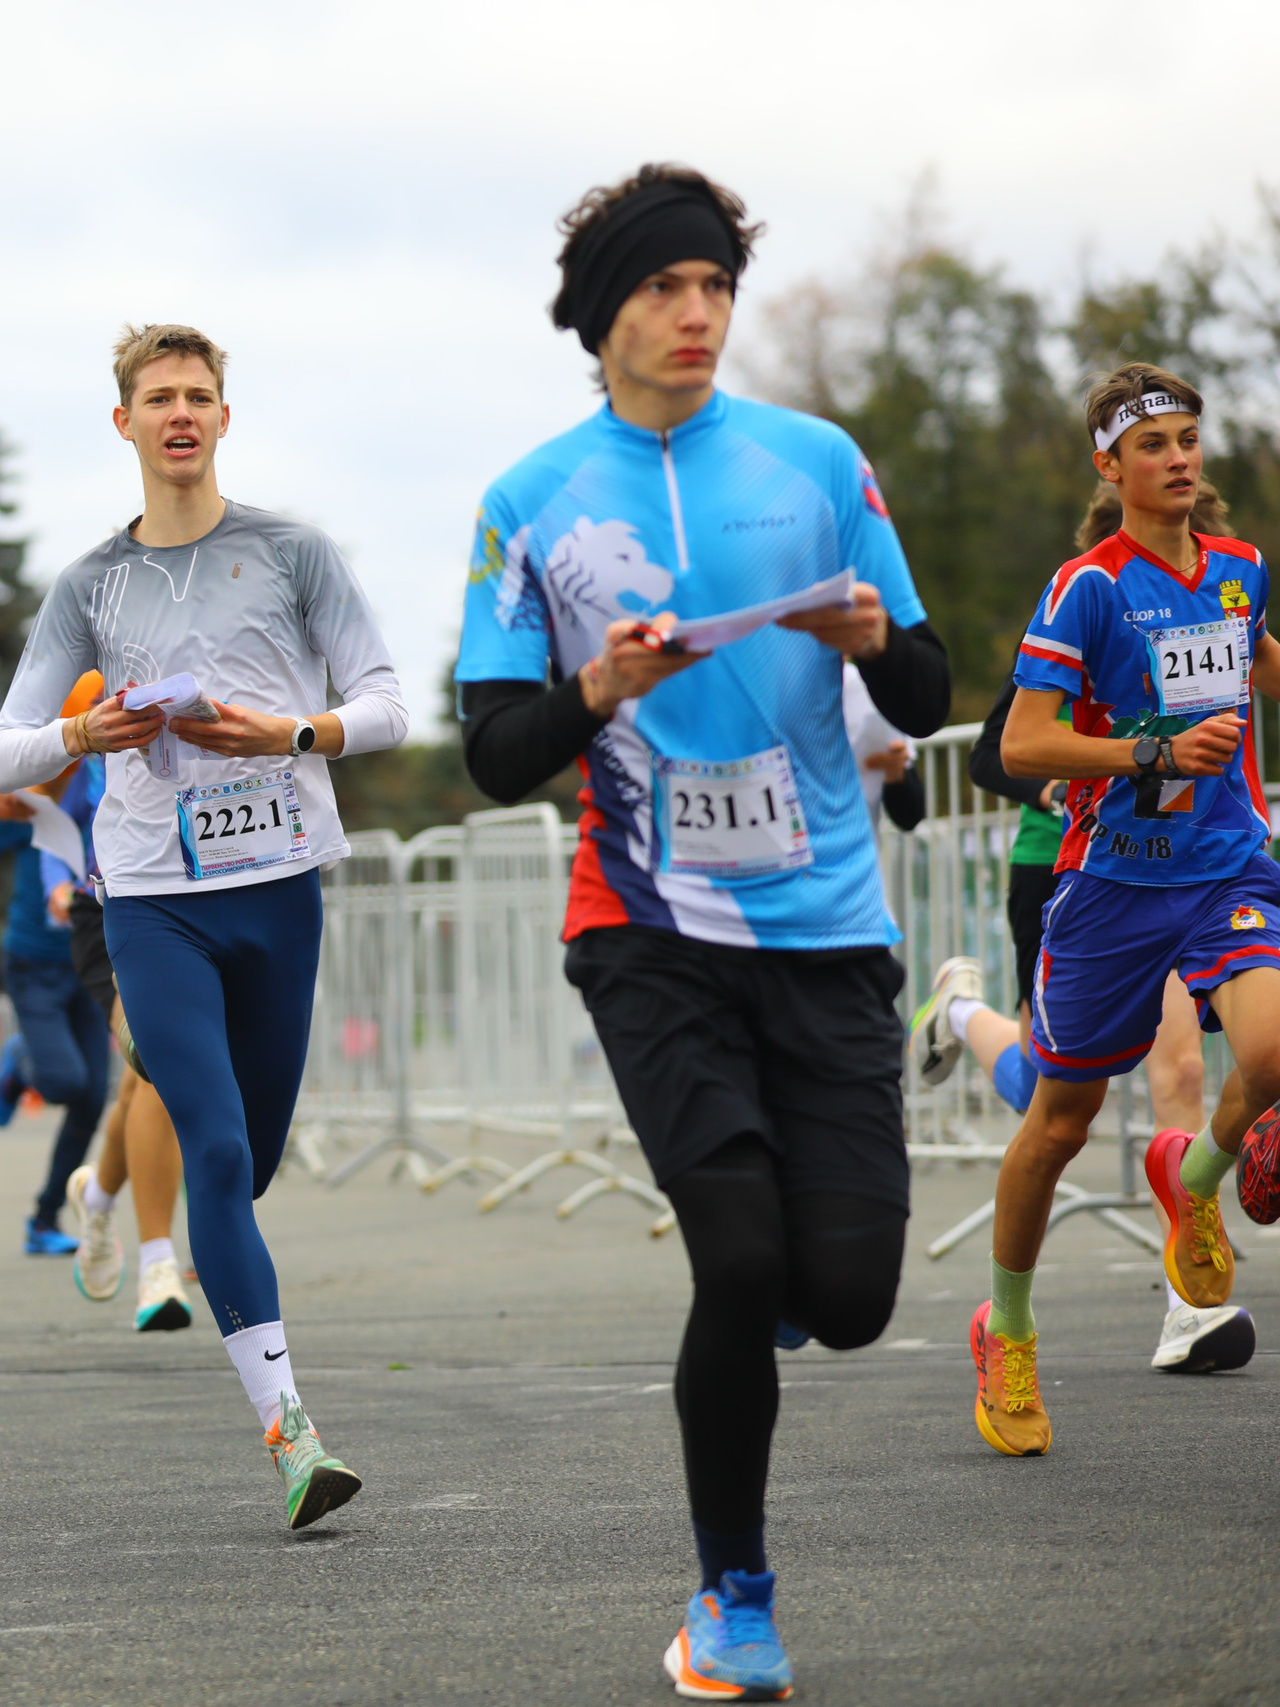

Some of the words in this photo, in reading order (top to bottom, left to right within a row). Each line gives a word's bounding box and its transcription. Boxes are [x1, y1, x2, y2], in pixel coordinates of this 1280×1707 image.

[1158, 607, 1172, 619] 18
[1163, 643, 1236, 680] 214.1
[195, 798, 285, 841] 222.1
[672, 785, 778, 830] 231.1
[1143, 836, 1173, 860] 18
[201, 860, 235, 871] ПЕРВЕНСТВО
[235, 857, 256, 865] РОССИИ
